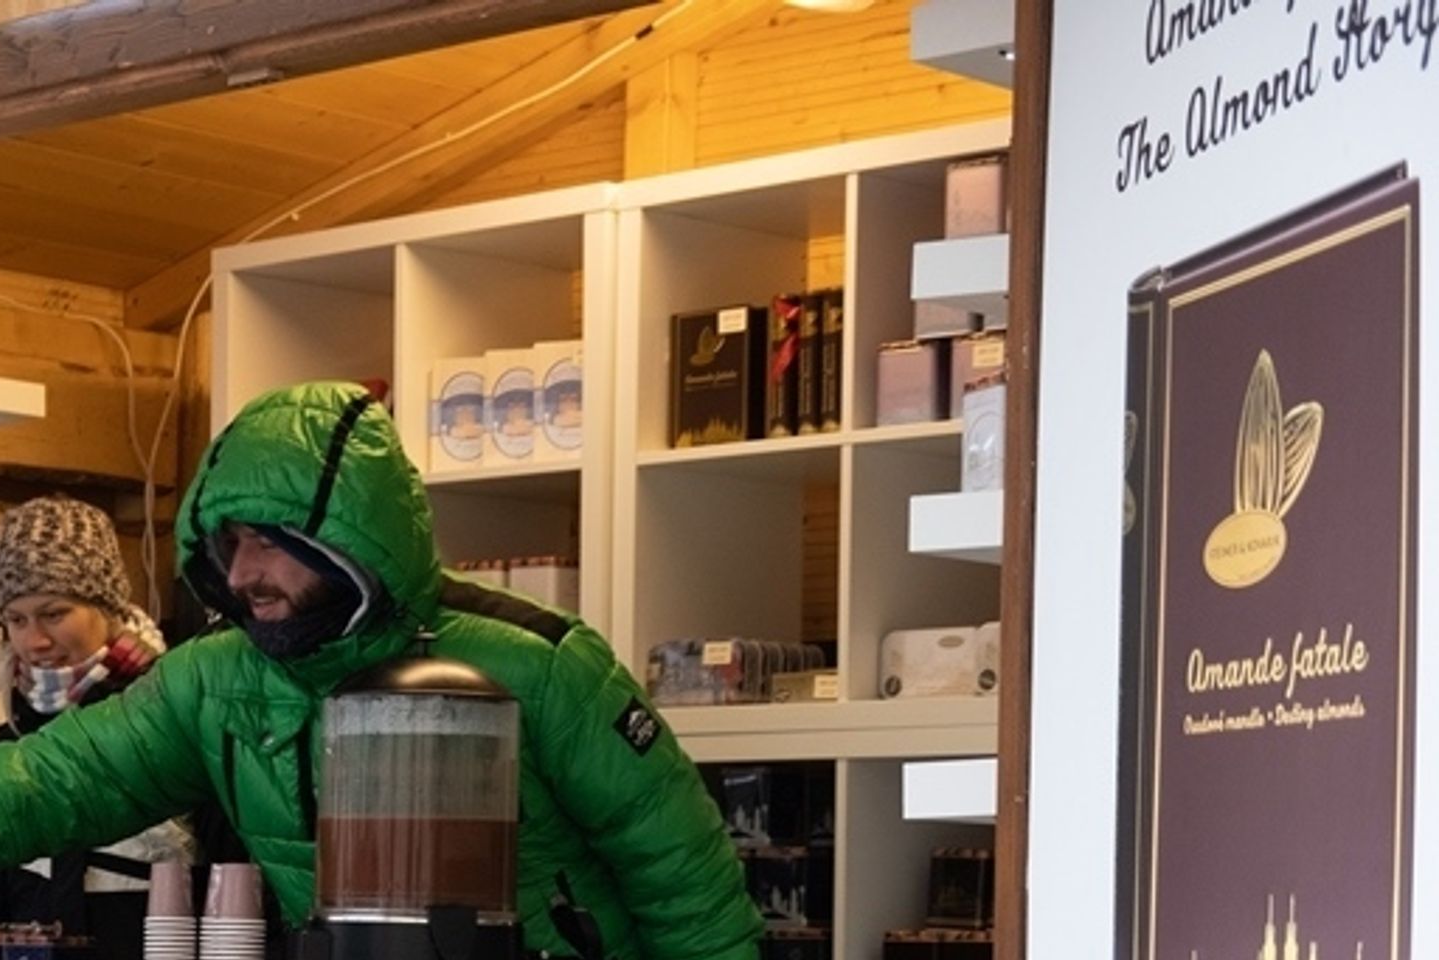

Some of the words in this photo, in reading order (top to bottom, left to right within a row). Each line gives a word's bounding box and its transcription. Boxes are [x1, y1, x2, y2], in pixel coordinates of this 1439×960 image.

[1116, 116, 1174, 192] The
[1186, 22, 1321, 158] Almond
[1332, 0, 1439, 82] Story
[1187, 637, 1286, 693] Amande
[1285, 623, 1369, 699] fatale
